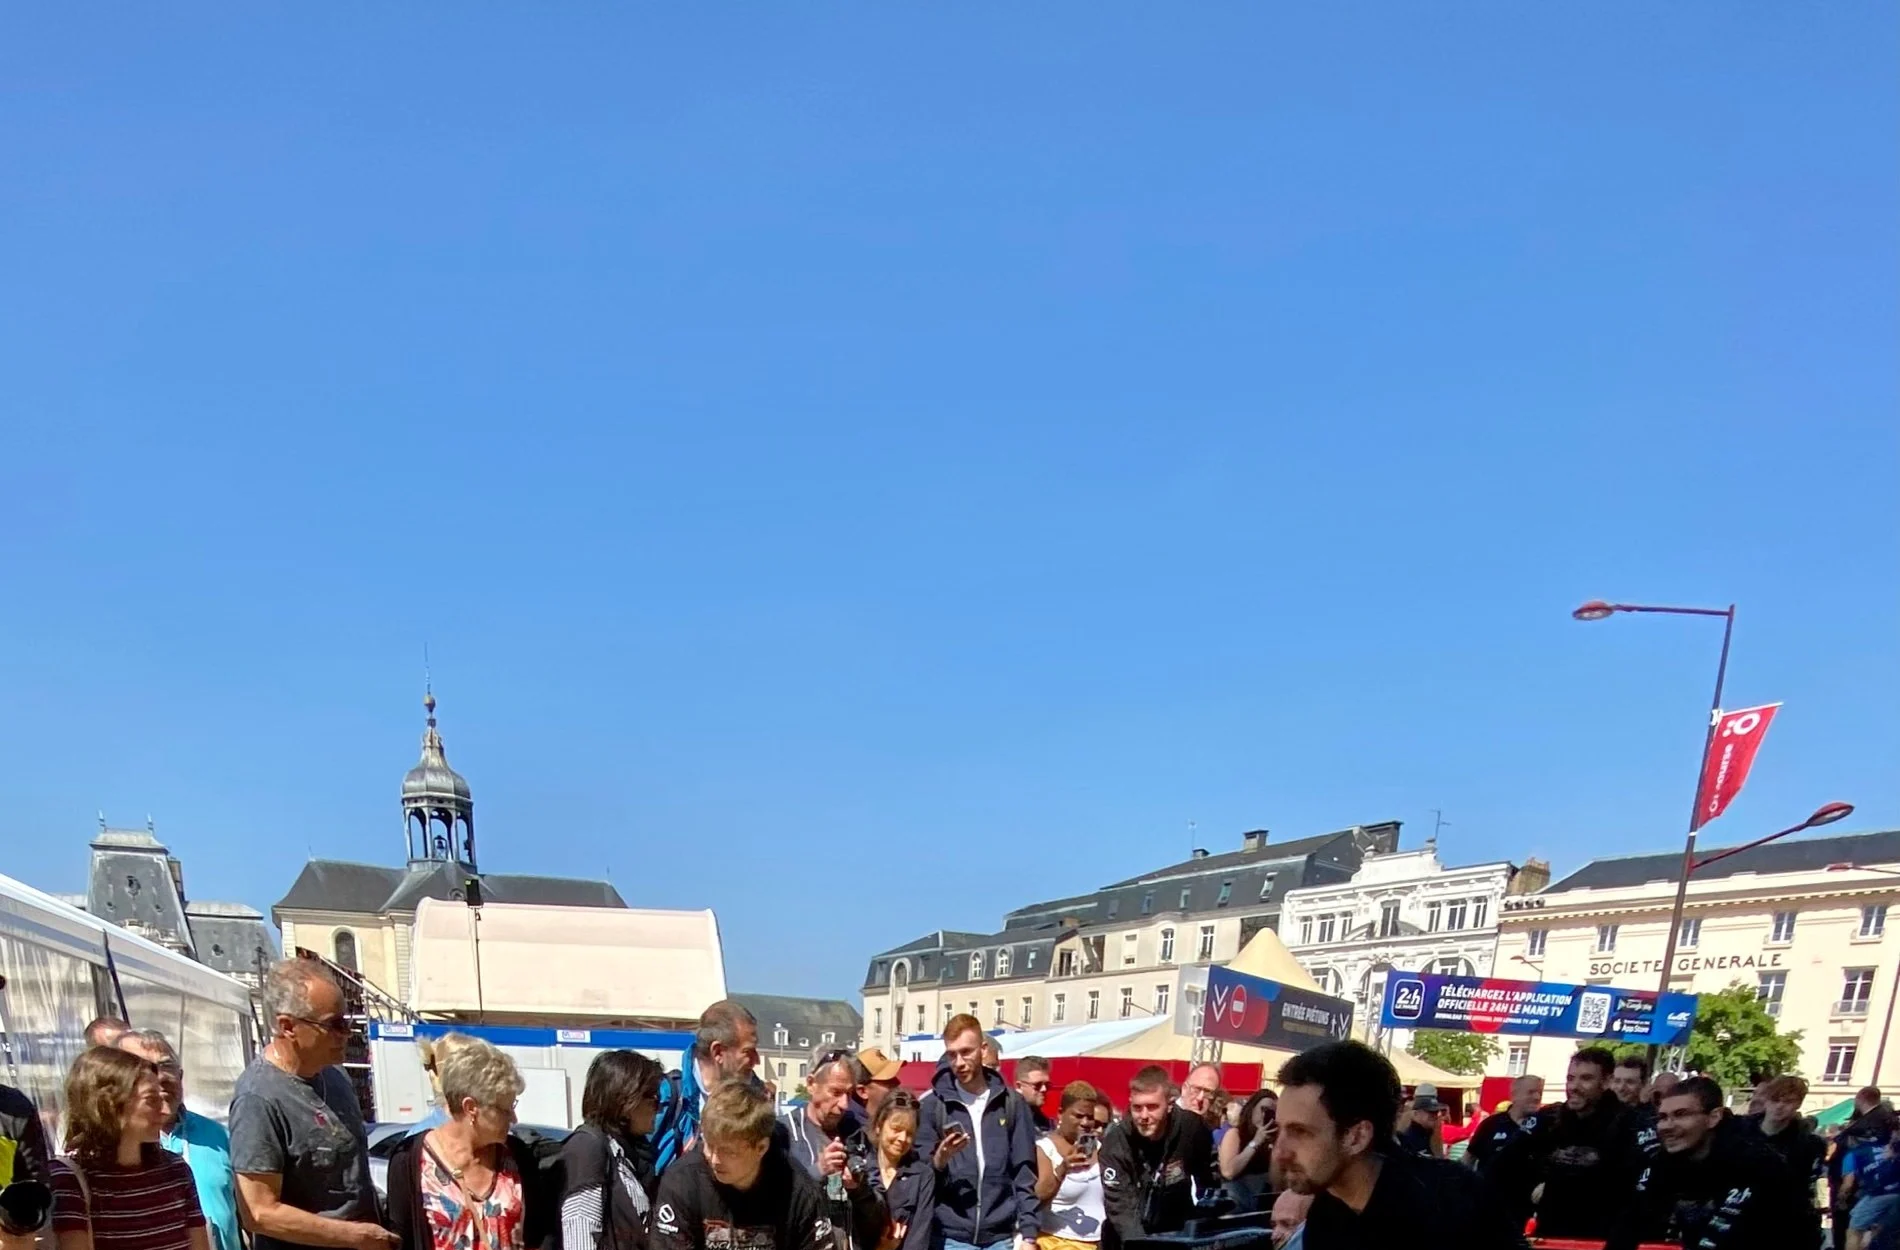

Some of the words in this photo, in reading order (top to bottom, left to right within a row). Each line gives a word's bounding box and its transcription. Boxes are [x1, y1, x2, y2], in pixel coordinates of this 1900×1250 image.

[1678, 953, 1782, 971] GENERALE
[1440, 984, 1505, 1000] TÉLÉCHARGEZ
[1505, 990, 1573, 1006] L'APPLICATION
[1437, 999, 1489, 1011] OFFICIELLE
[1489, 1002, 1508, 1013] 24H
[1509, 1004, 1521, 1014] LE
[1521, 1005, 1549, 1017] MANS
[1550, 1007, 1564, 1017] TV
